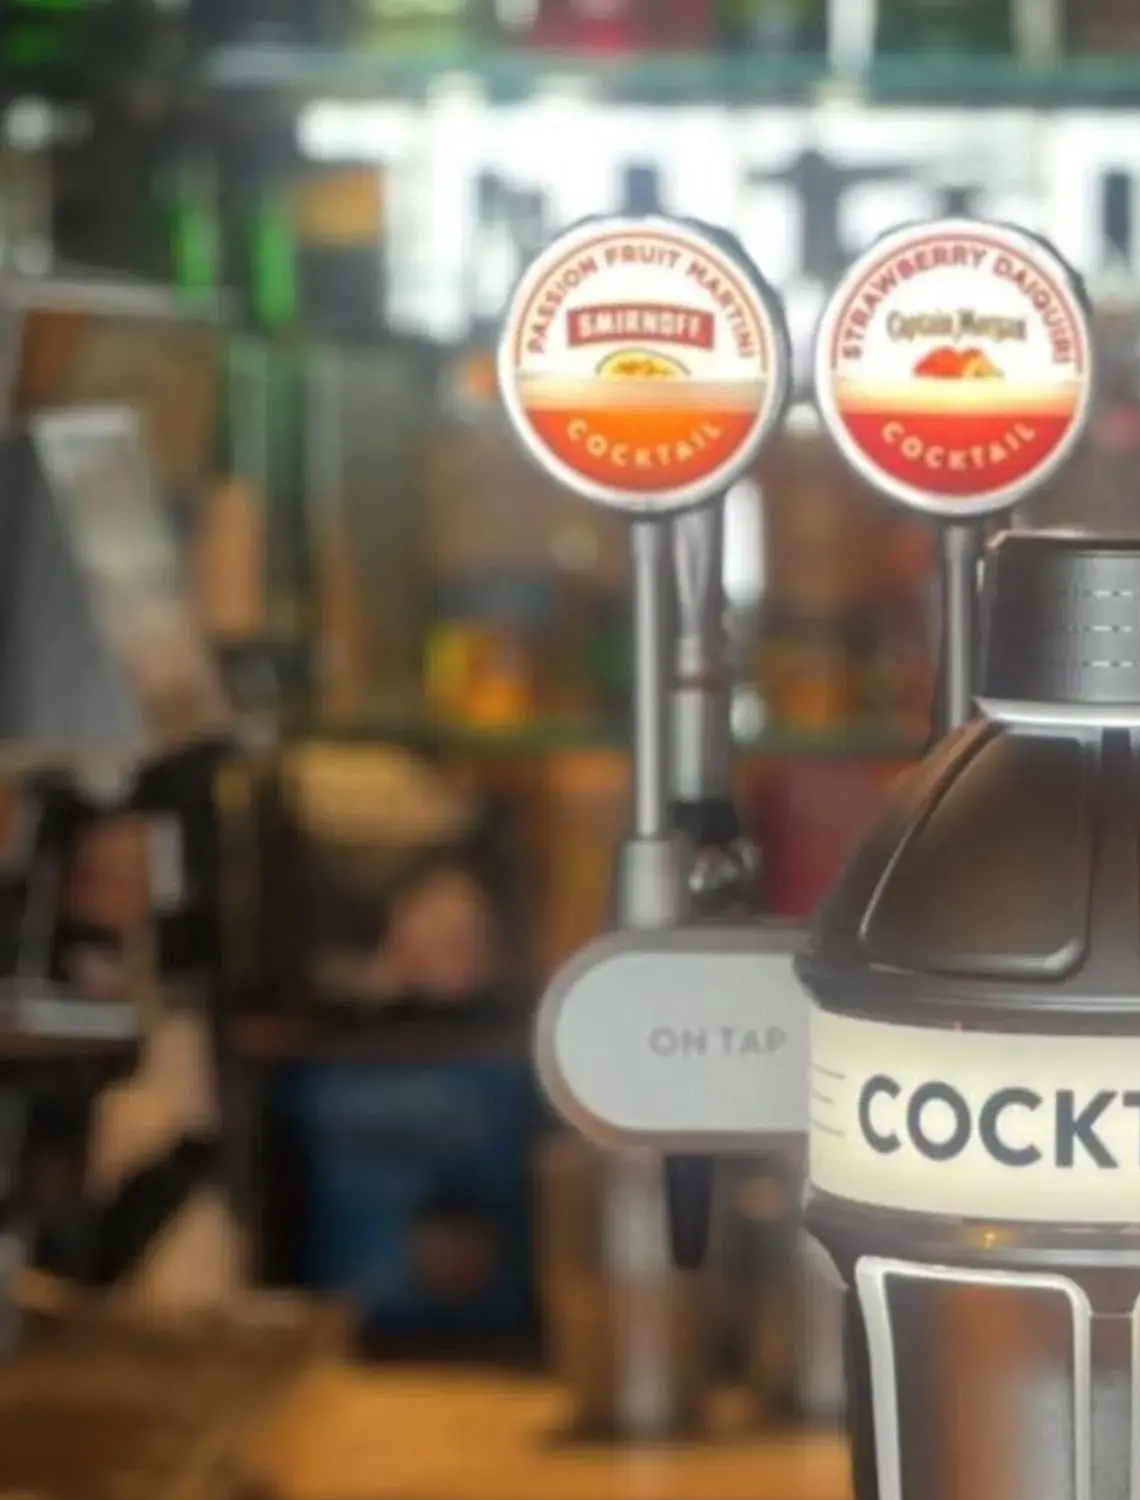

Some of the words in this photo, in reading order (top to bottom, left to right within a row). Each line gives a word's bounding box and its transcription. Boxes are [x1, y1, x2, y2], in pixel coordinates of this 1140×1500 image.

[528, 255, 599, 354] PASSION
[603, 244, 682, 267] FRUIT
[686, 259, 756, 359] MARTINI
[576, 308, 701, 340] SMIRNOFF
[841, 245, 988, 360] STRAWBERRY
[992, 256, 1072, 365] DAIQUIRI
[566, 418, 723, 468] COCKTAIL
[881, 420, 1037, 470] COCKTAIL
[648, 1026, 707, 1058] ON
[719, 1025, 788, 1058] TAP
